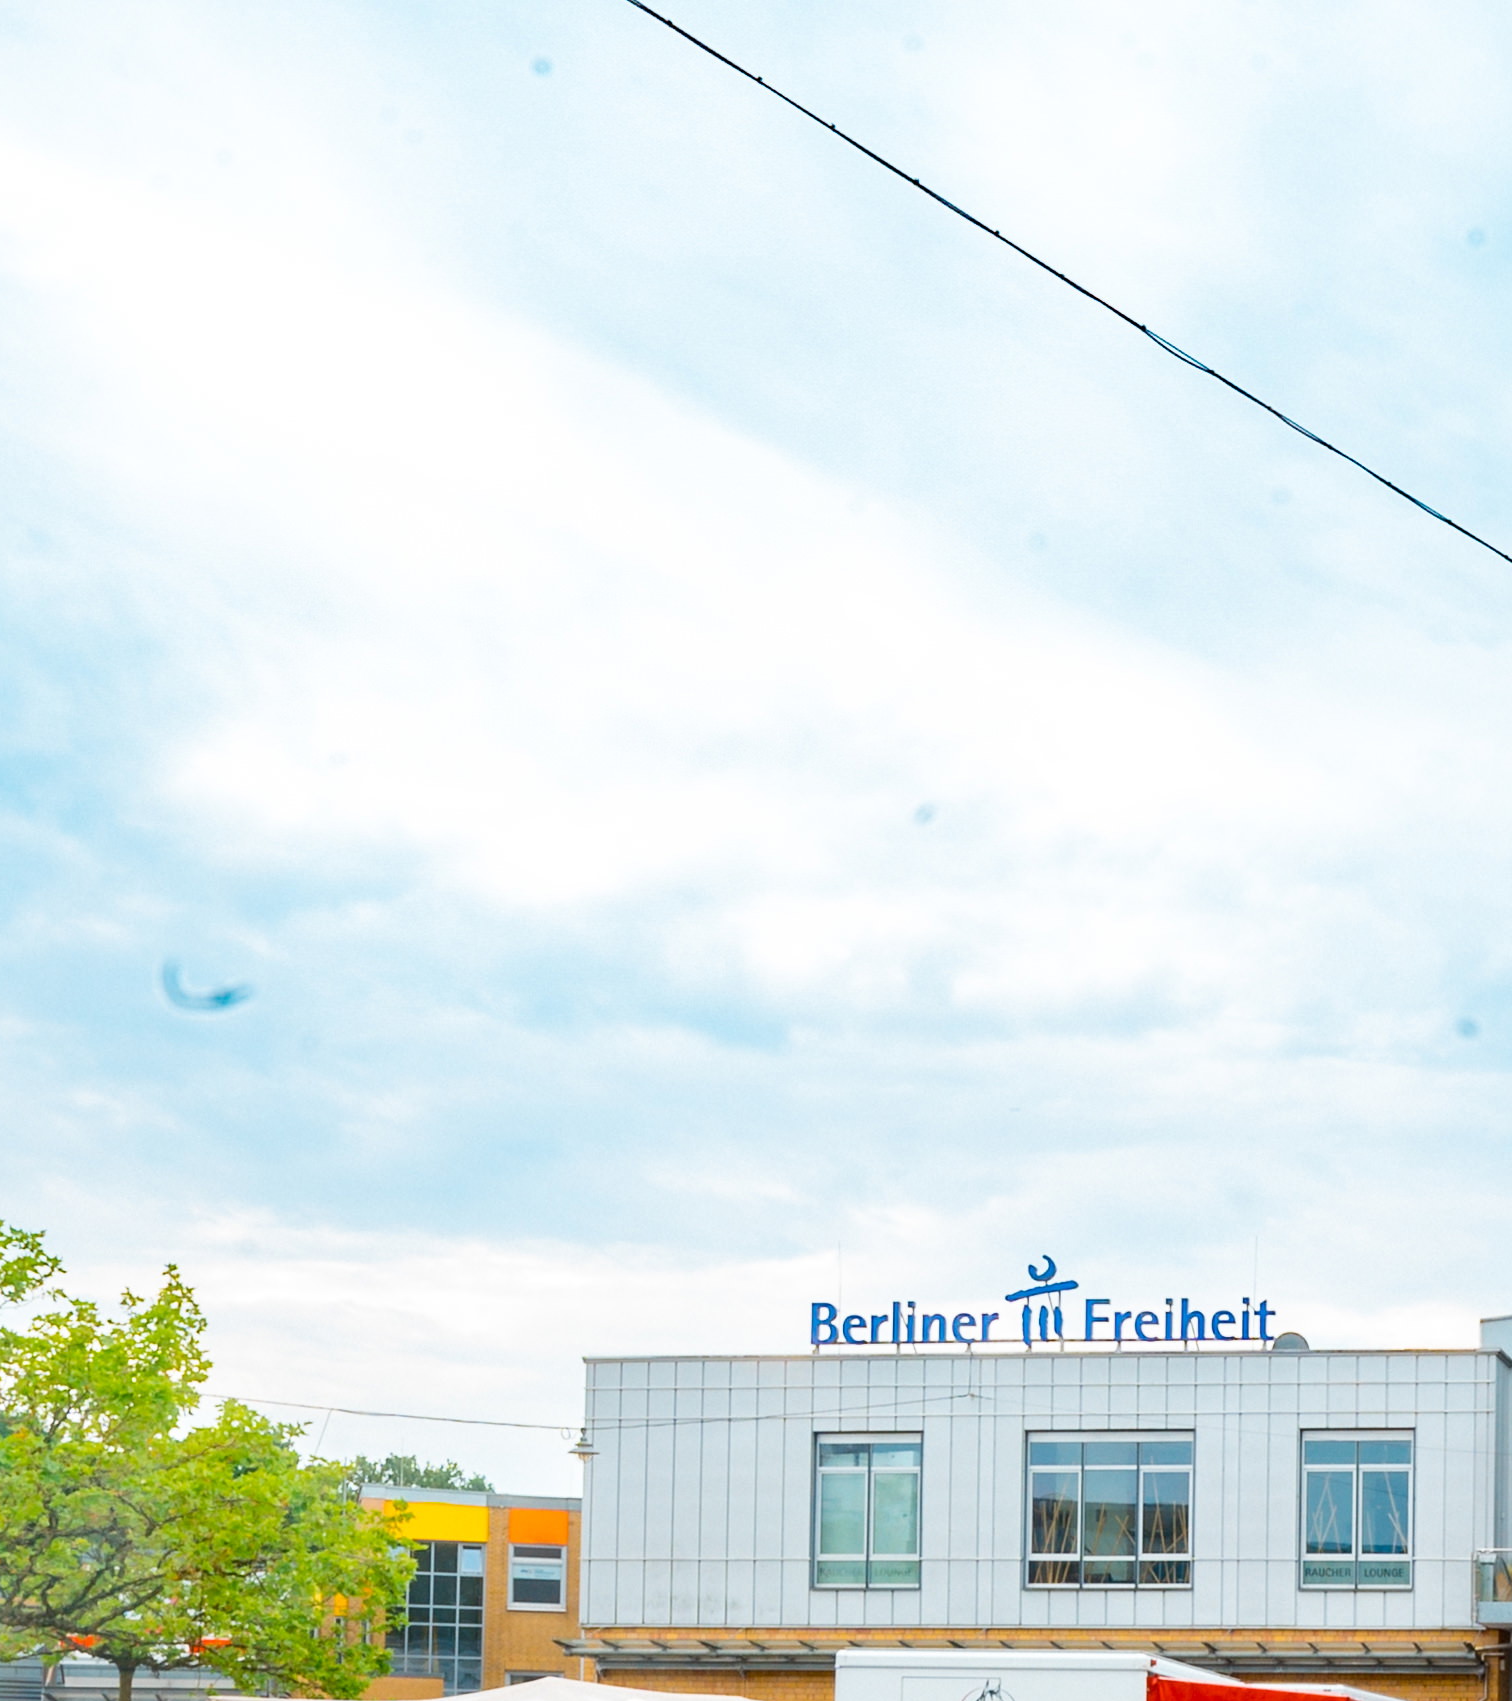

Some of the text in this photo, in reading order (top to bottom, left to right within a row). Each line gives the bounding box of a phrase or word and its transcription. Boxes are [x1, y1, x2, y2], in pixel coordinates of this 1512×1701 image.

[810, 1297, 1276, 1345] Berliner Freiheit
[1304, 1567, 1404, 1578] RAUCHER LOUNGE
